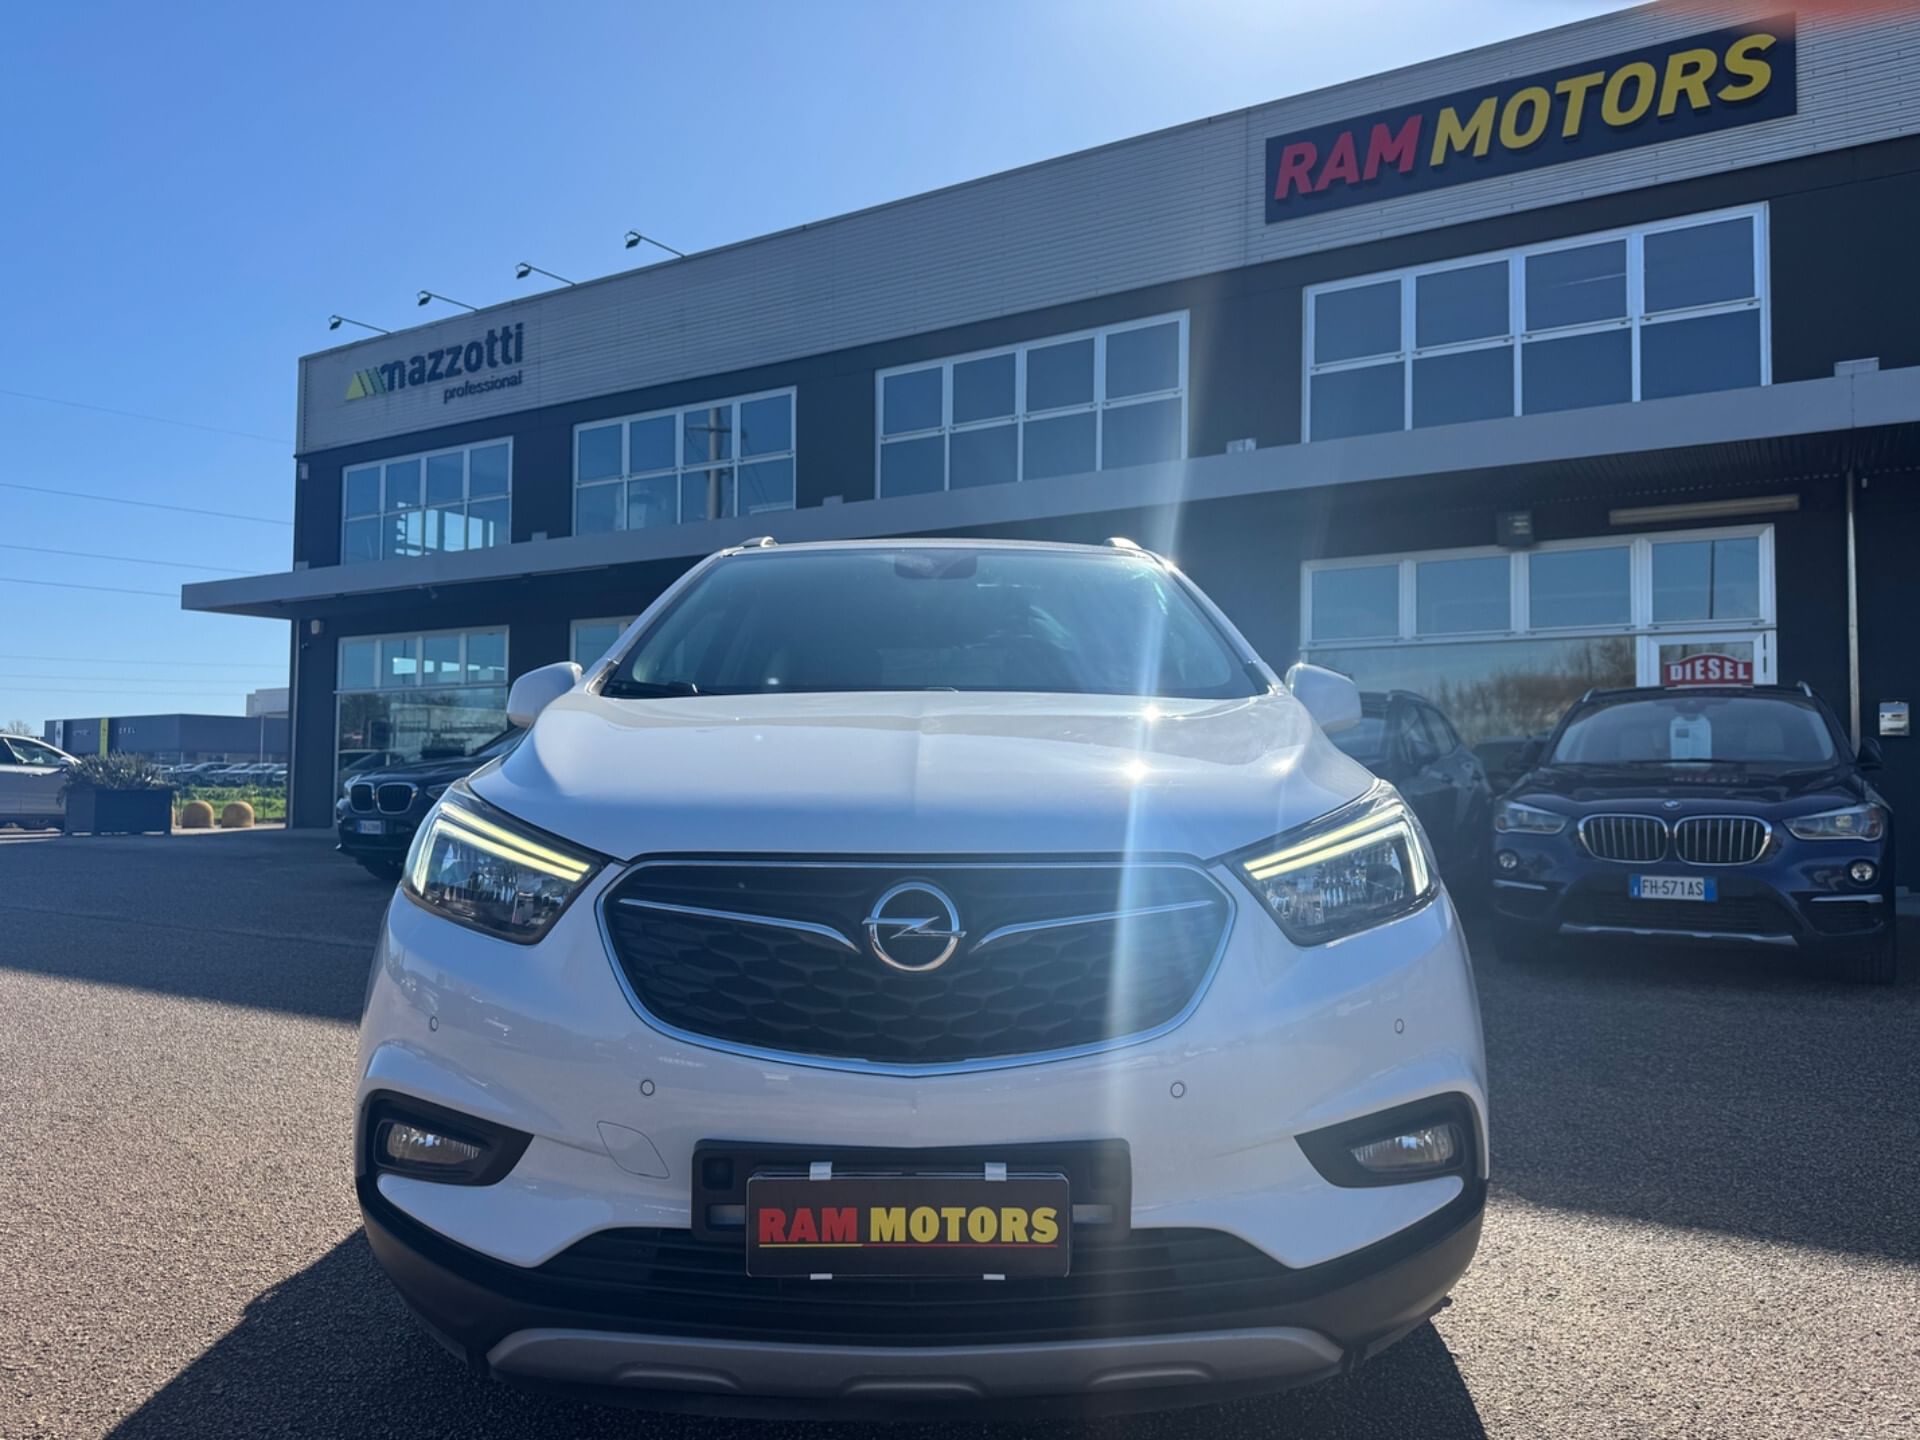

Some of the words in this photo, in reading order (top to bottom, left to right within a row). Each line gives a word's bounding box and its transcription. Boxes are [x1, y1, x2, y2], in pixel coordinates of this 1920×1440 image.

[1274, 114, 1422, 201] RAM
[1429, 33, 1777, 167] MOTORS
[380, 322, 524, 392] mazzotti
[443, 370, 523, 404] professional
[1669, 658, 1749, 681] DIESEL
[758, 1207, 858, 1243] RAM
[869, 1206, 1060, 1244] MOTORS
